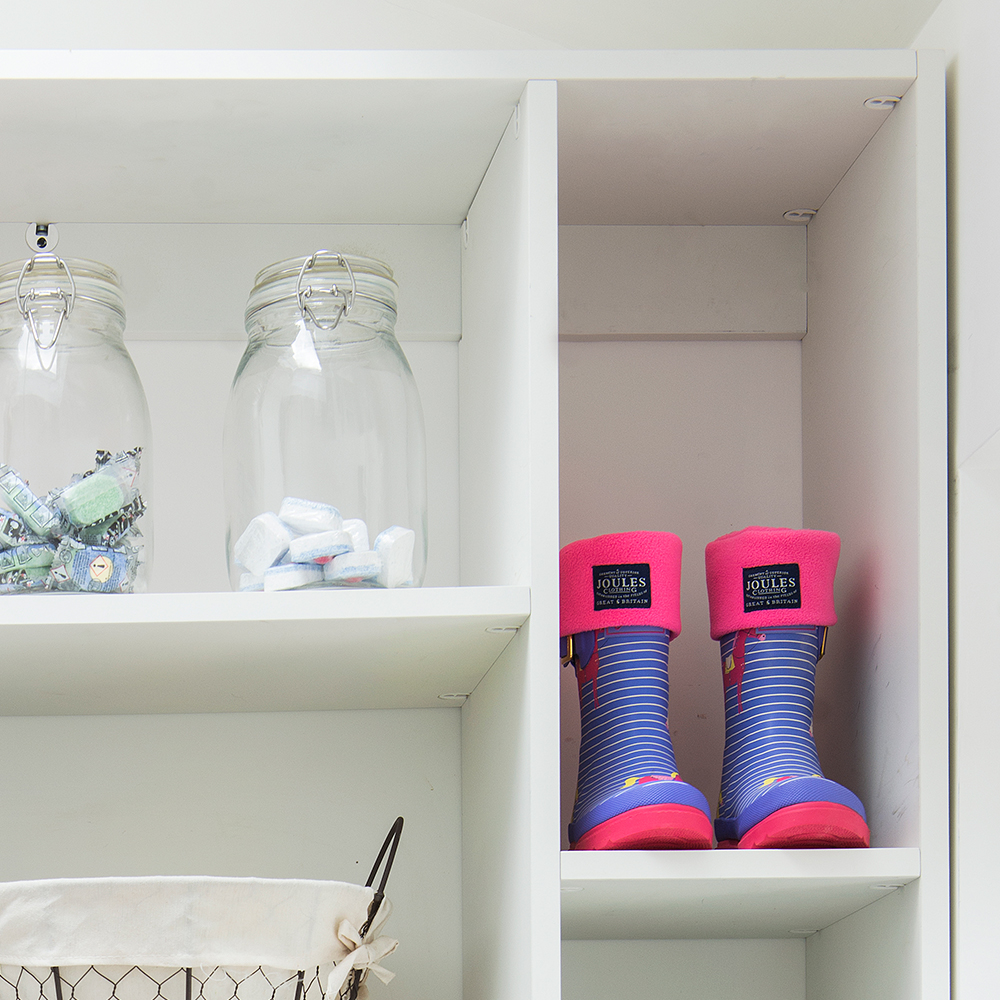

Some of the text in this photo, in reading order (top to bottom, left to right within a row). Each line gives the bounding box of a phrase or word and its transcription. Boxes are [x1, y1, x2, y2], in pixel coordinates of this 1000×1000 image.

[596, 577, 646, 589] JOULES
[746, 577, 796, 591] JOULES
[752, 587, 787, 595] CLOTHING
